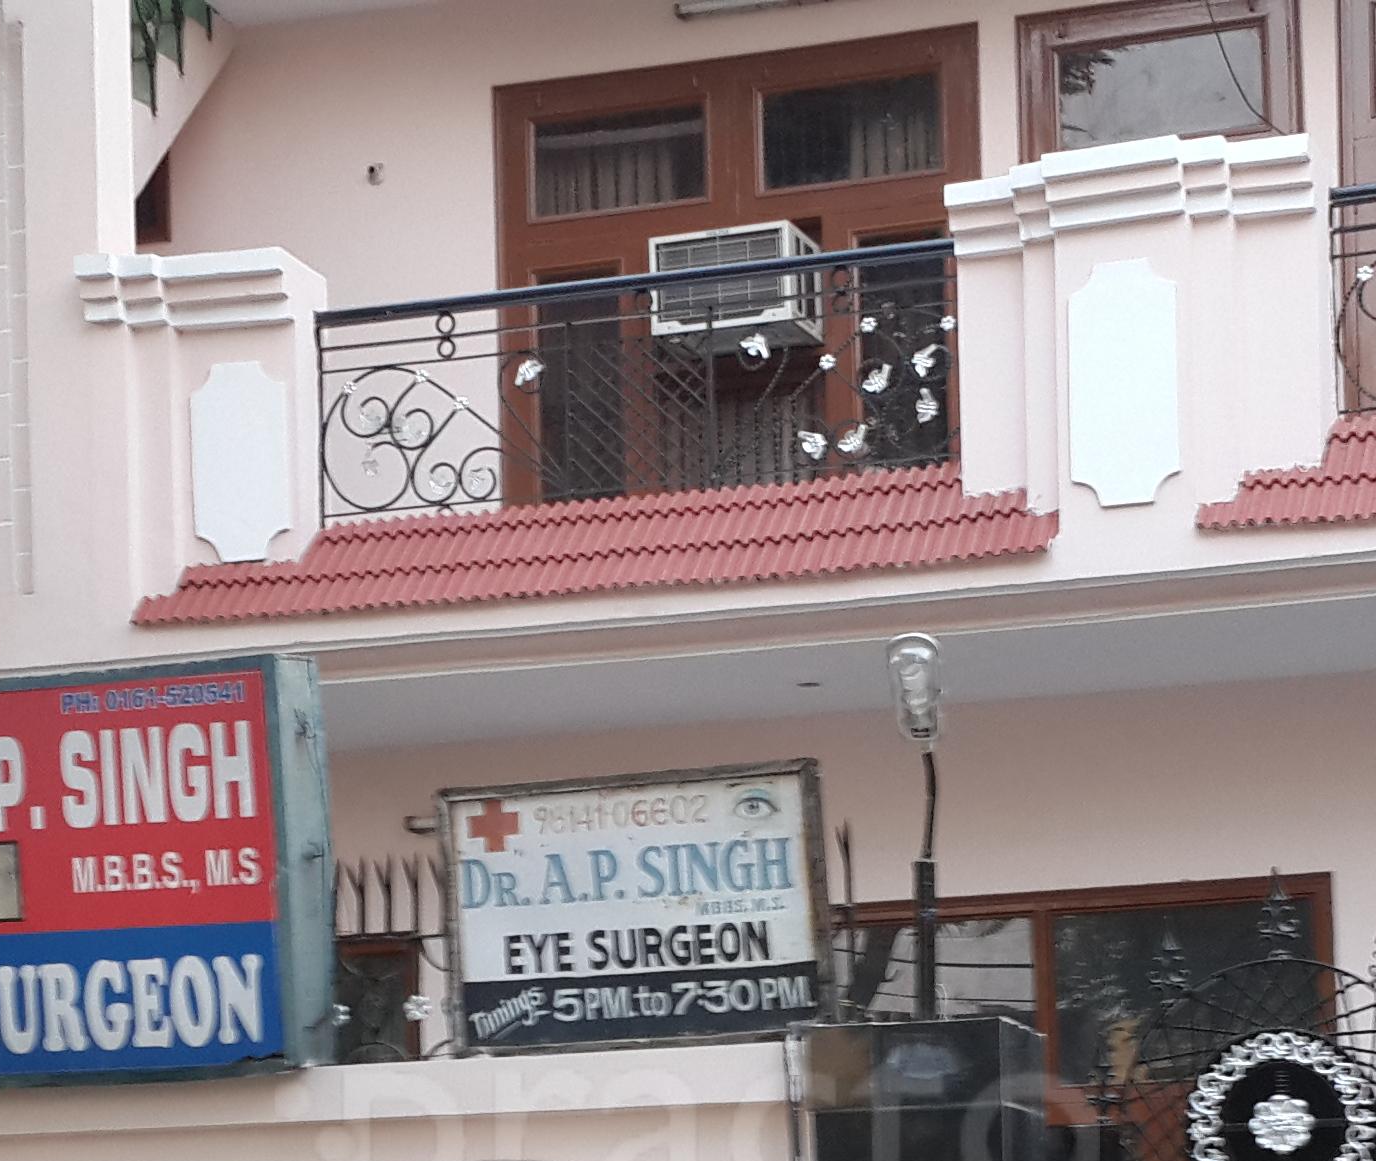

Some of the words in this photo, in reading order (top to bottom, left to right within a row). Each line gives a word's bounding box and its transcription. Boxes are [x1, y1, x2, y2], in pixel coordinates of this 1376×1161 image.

[59, 720, 258, 829] SINGH
[205, 847, 262, 887] M.S
[540, 849, 626, 904] A.P.
[637, 837, 792, 899] SINGH
[503, 932, 575, 975] EYE
[587, 921, 770, 970] SURGEON
